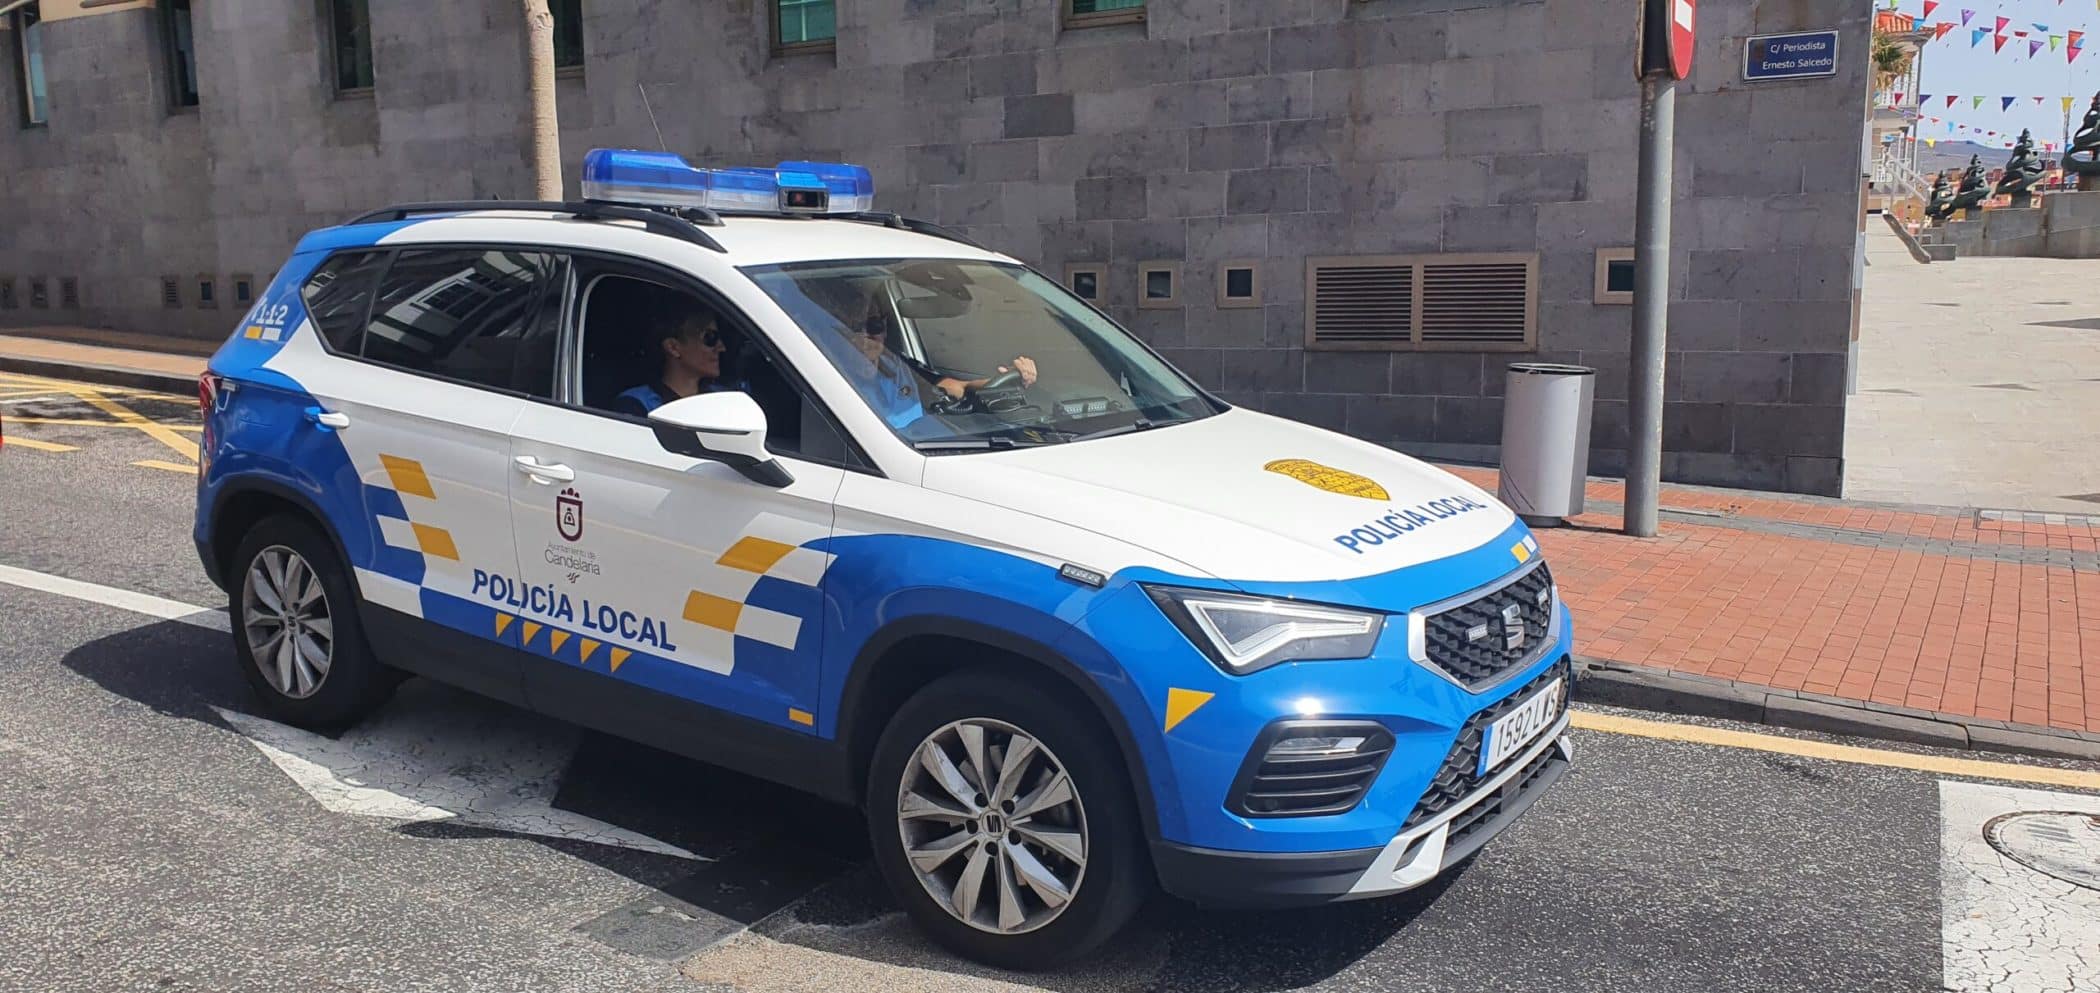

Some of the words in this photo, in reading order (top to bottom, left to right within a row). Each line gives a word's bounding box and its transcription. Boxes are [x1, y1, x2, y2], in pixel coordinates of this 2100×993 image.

[1762, 60, 1795, 70] Ernesto
[1798, 57, 1833, 68] Salcedo
[1770, 44, 1781, 53] C/
[1783, 40, 1826, 51] Periodista
[1333, 509, 1435, 554] POLICÍA
[1416, 495, 1488, 519] LOCAL
[545, 549, 600, 576] Candelaria
[472, 568, 574, 623] POLICÍA
[582, 600, 677, 652] LOCAL
[1497, 706, 1532, 758] 1592
